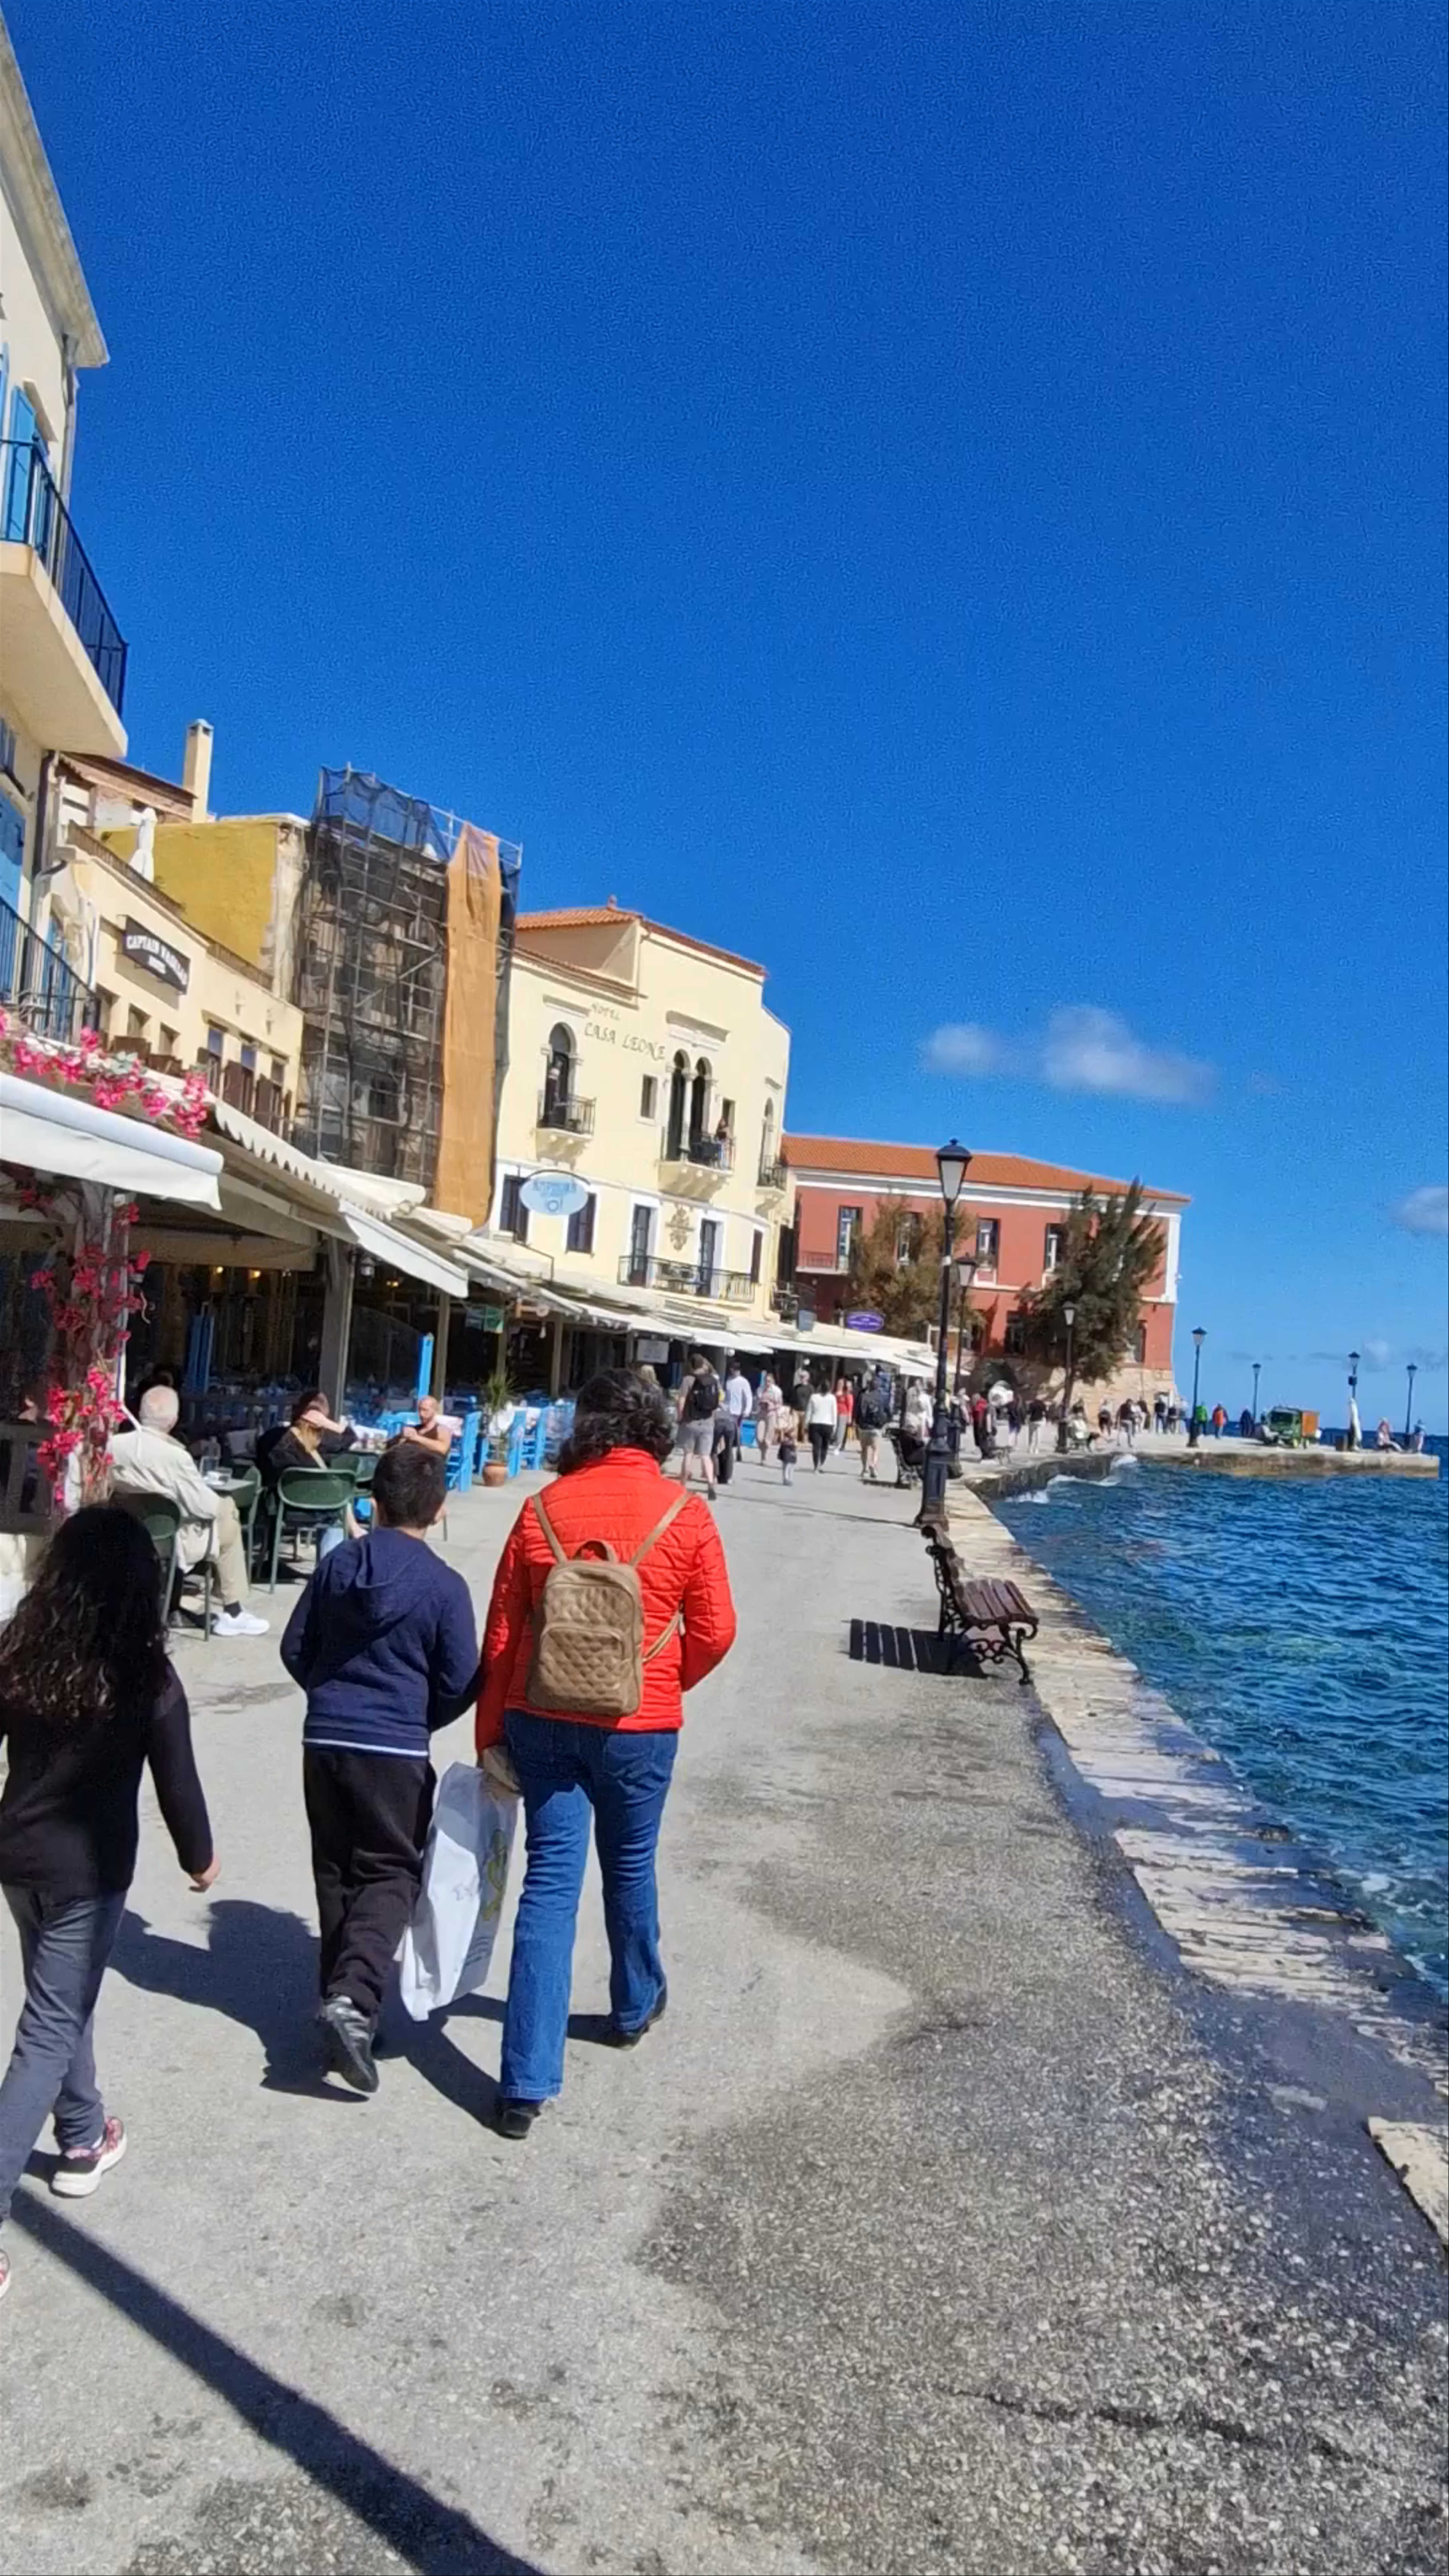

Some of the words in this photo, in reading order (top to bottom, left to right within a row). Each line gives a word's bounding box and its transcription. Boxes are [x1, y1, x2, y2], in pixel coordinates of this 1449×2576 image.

[126, 935, 160, 955] CAPTAIN
[591, 1003, 621, 1021] HOTEL
[584, 1022, 616, 1044] CASA
[622, 1033, 666, 1061] LEONE
